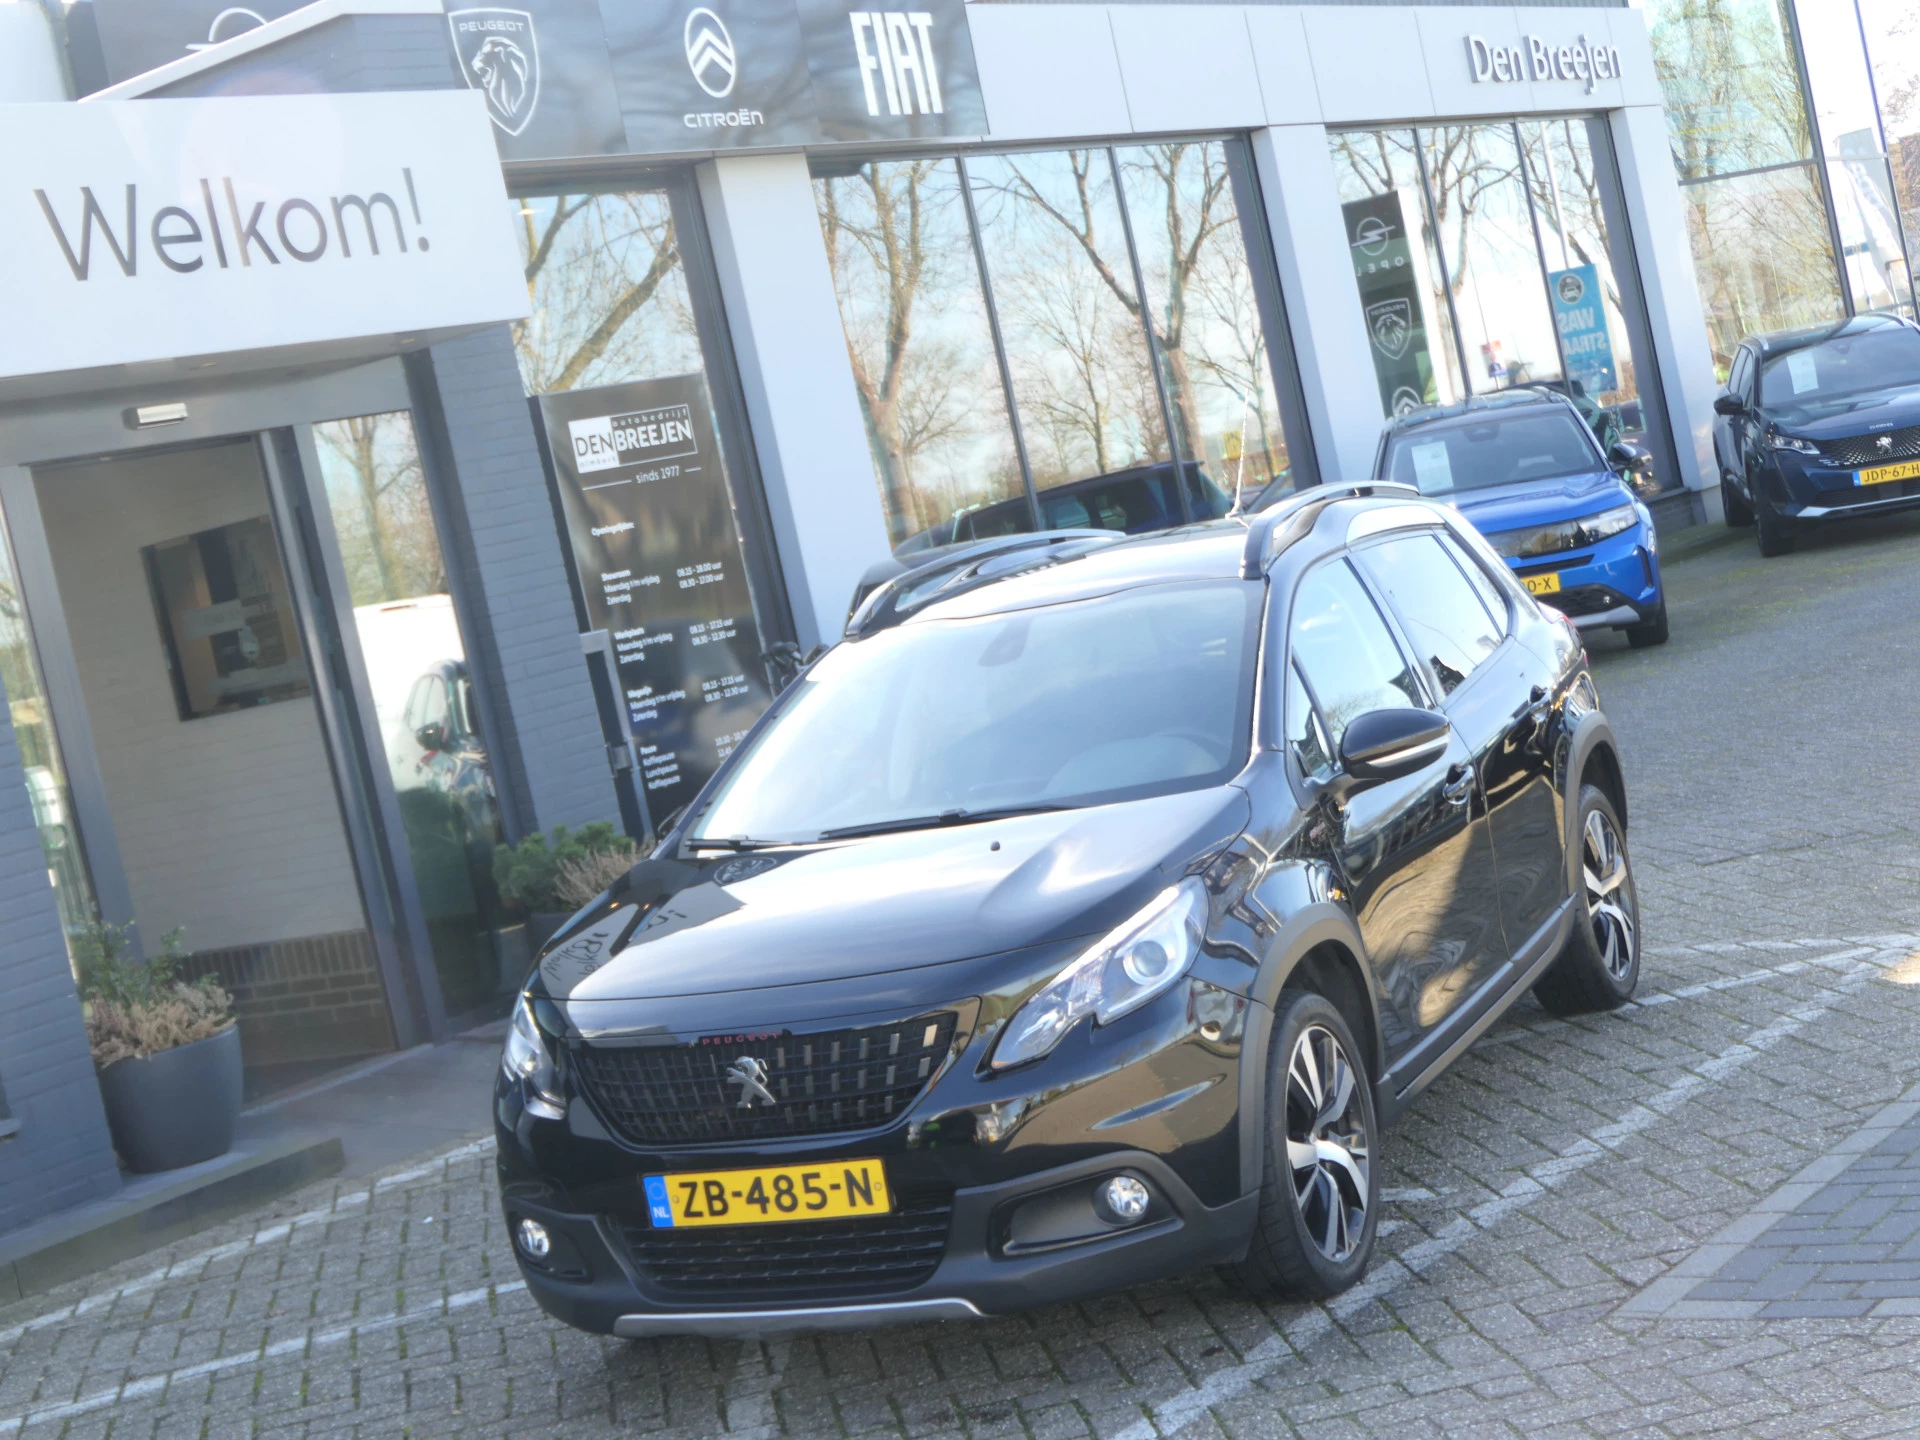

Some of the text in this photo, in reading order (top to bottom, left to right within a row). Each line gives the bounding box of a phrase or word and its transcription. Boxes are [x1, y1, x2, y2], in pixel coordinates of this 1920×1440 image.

[458, 20, 525, 33] PEUGEOT
[849, 11, 944, 117] FIAT
[1465, 33, 1624, 95] Den Breejen
[684, 109, 764, 129] CITROËN
[34, 167, 431, 282] Welkom!
[612, 408, 687, 428] autobedrijf
[575, 419, 693, 456] DEN BREEJEN
[636, 465, 680, 484] sinds 1977
[1865, 463, 1920, 483] JDP-67-H
[702, 1032, 779, 1045] PEUGEOT
[653, 1168, 875, 1219] NL ZB-485-N
